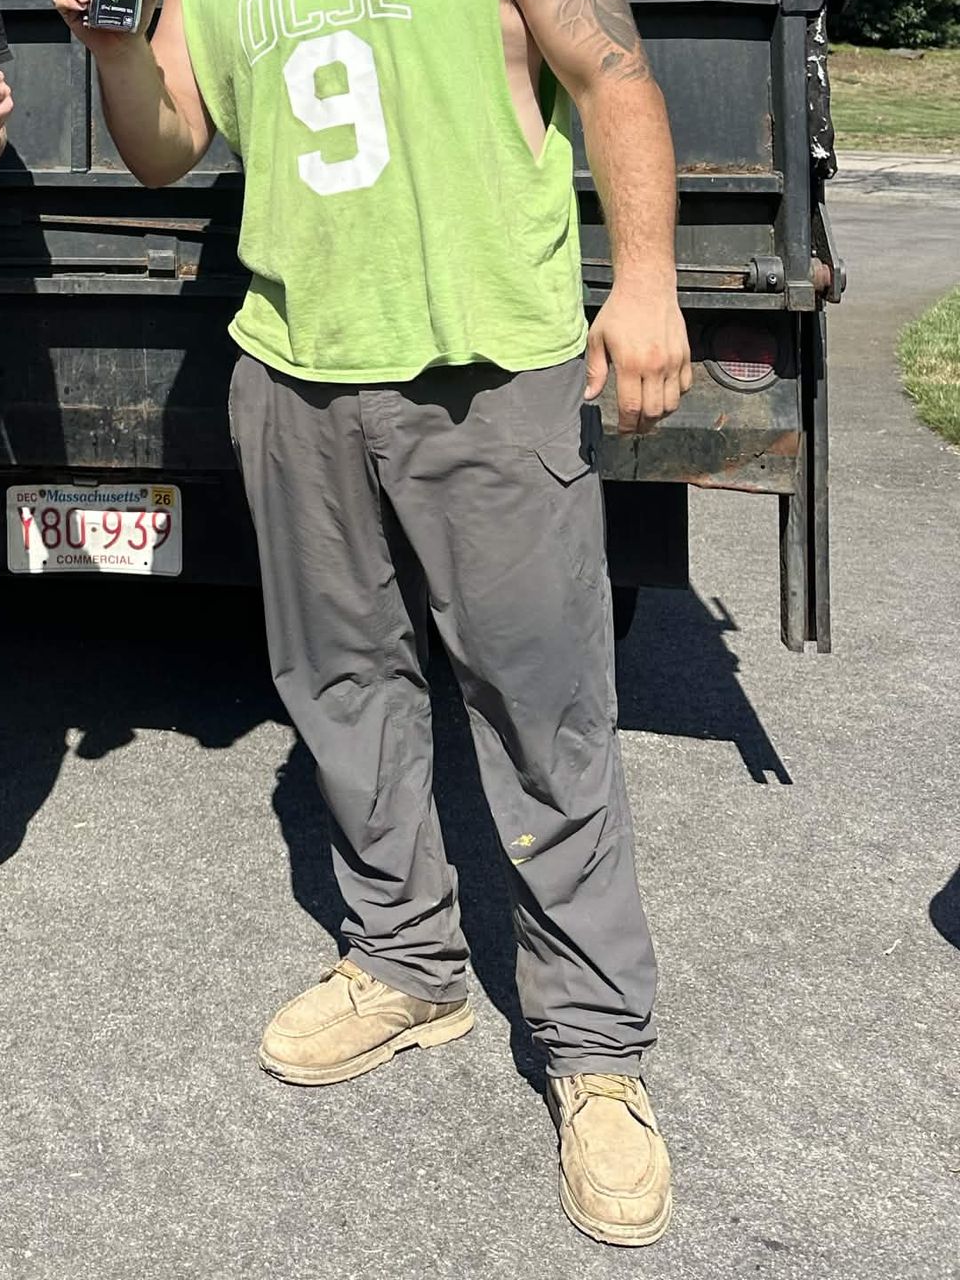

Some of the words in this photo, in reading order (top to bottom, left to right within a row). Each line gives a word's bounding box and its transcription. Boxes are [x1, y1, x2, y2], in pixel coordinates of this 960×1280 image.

[283, 30, 390, 196] 9
[17, 493, 38, 503] DEC
[45, 489, 141, 503] Massachusetts
[154, 493, 171, 506] 26
[56, 554, 134, 565] COMMERCIAL
